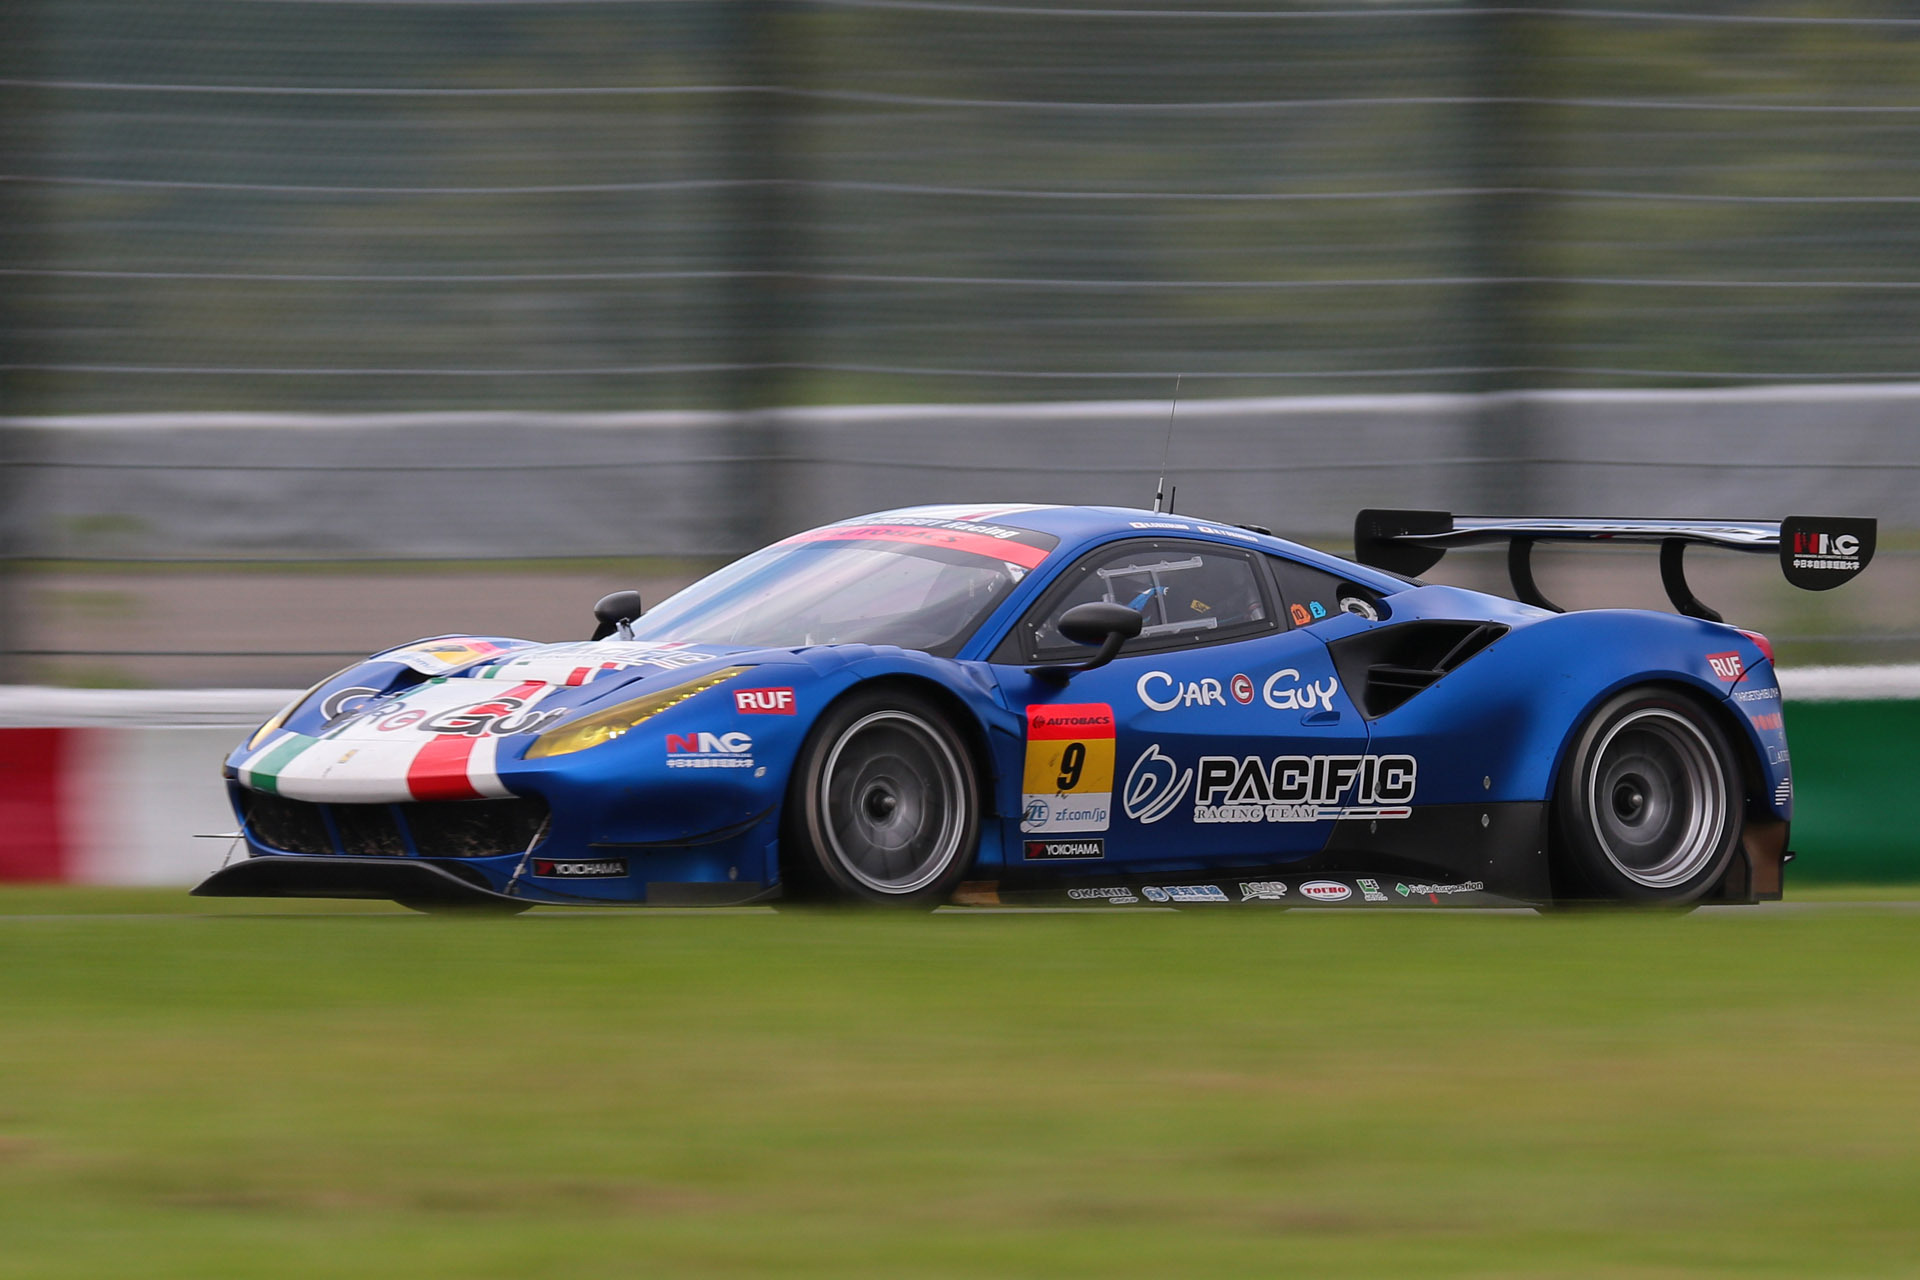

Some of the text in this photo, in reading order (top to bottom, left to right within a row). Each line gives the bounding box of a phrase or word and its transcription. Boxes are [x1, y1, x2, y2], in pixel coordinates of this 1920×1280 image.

[1709, 655, 1743, 677] RUF
[736, 691, 793, 709] RUF
[1136, 671, 1226, 711] CAR
[1046, 716, 1110, 726] AUTOBACS
[1056, 742, 1086, 790] 9
[1196, 756, 1416, 804] PACIFIC
[1027, 804, 1107, 823] ZF zf.com/jp
[1195, 807, 1316, 820] RACING TEAM
[1045, 843, 1100, 856] YOKOHAMA
[553, 862, 624, 875] YOKOHAMA
[1068, 887, 1131, 899] OKAKIN
